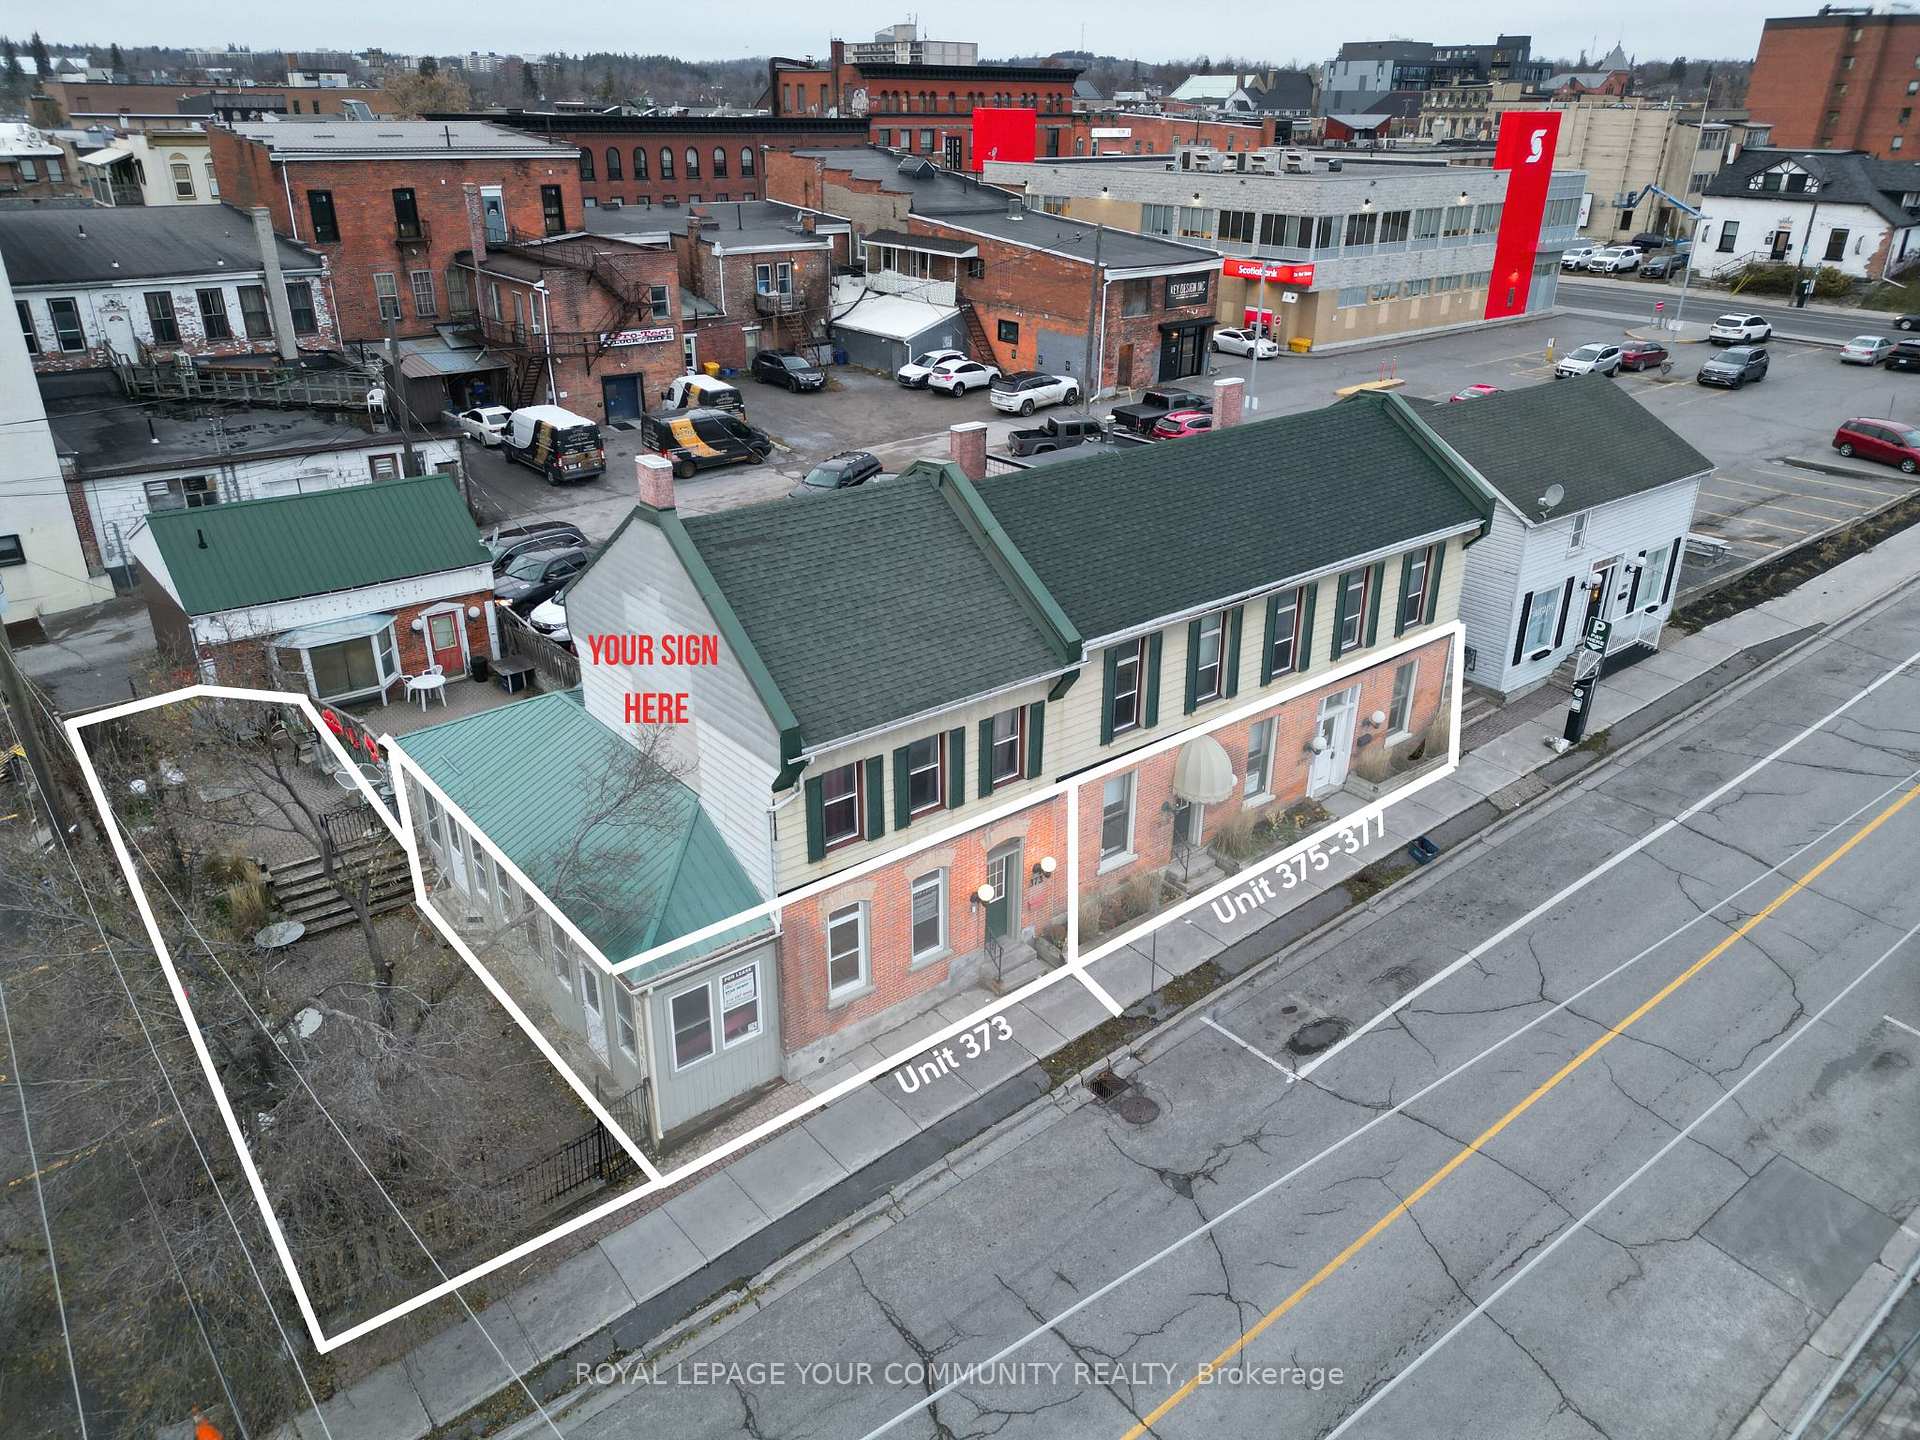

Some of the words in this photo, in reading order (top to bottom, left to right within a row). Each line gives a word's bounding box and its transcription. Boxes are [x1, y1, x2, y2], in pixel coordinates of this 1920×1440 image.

[1170, 284, 1180, 295] KEY
[1180, 282, 1197, 294] DESIGN
[1593, 620, 1606, 633] P
[1587, 636, 1605, 646] HERE
[1590, 633, 1603, 641] PAY
